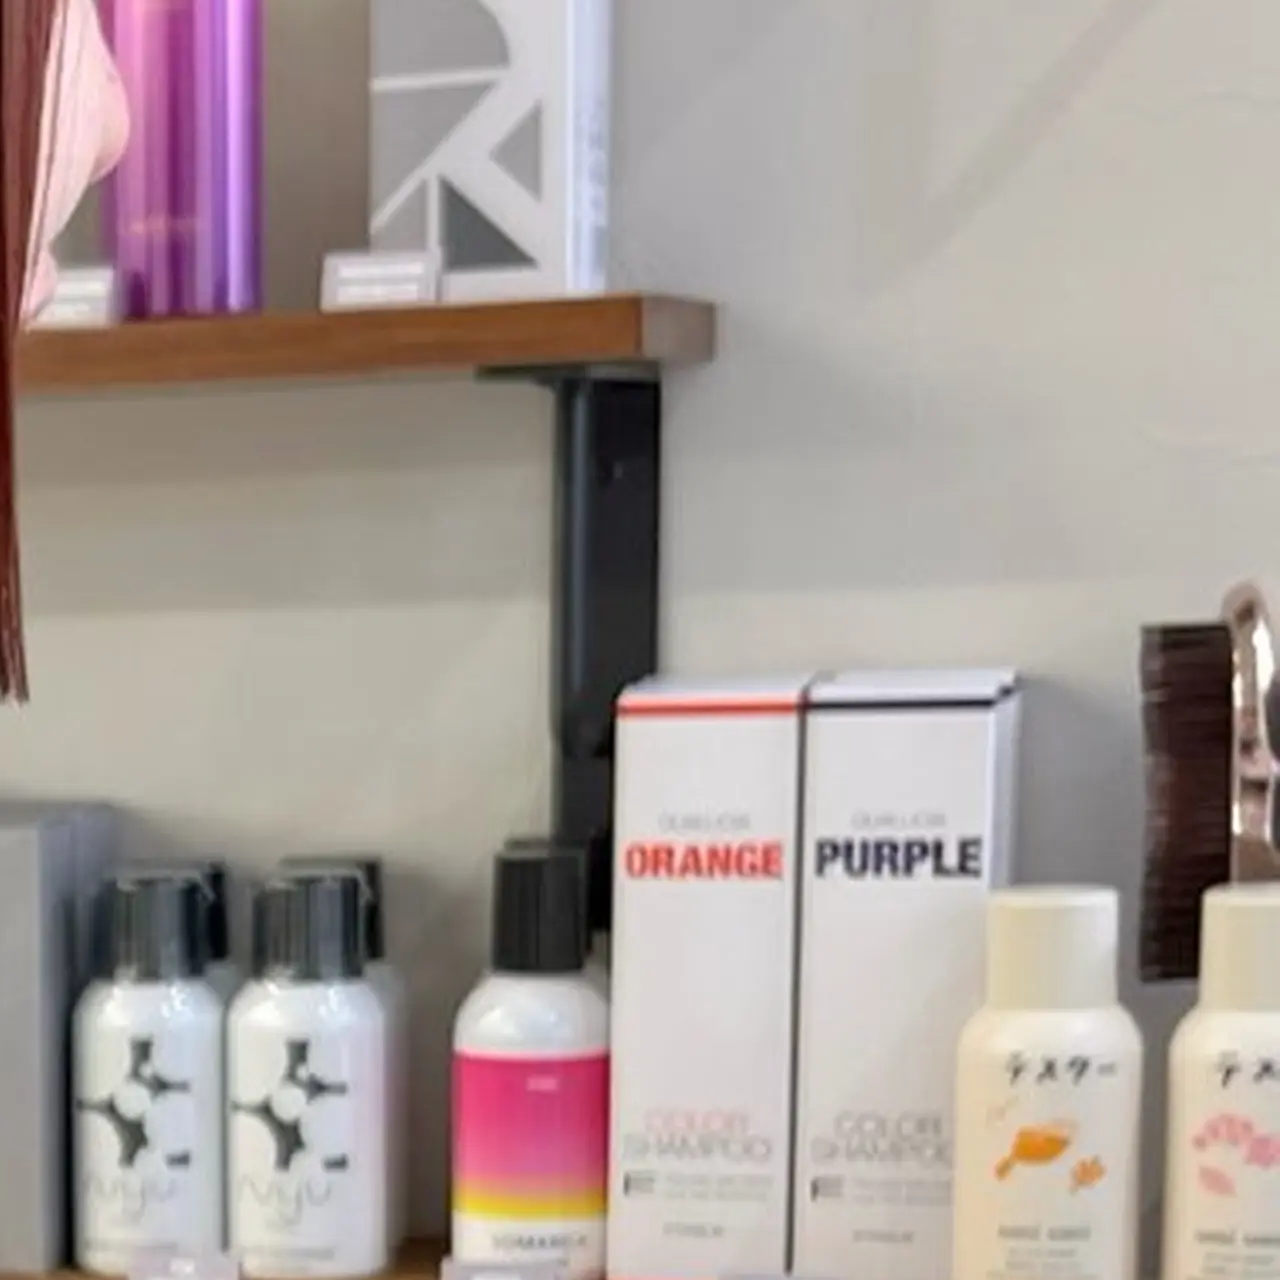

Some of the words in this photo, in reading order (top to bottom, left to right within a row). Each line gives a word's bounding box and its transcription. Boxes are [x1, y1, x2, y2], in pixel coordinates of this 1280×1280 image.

[624, 841, 784, 879] ORANGE
[813, 838, 983, 878] PURPLE
[1006, 1052, 1118, 1086] テスター
